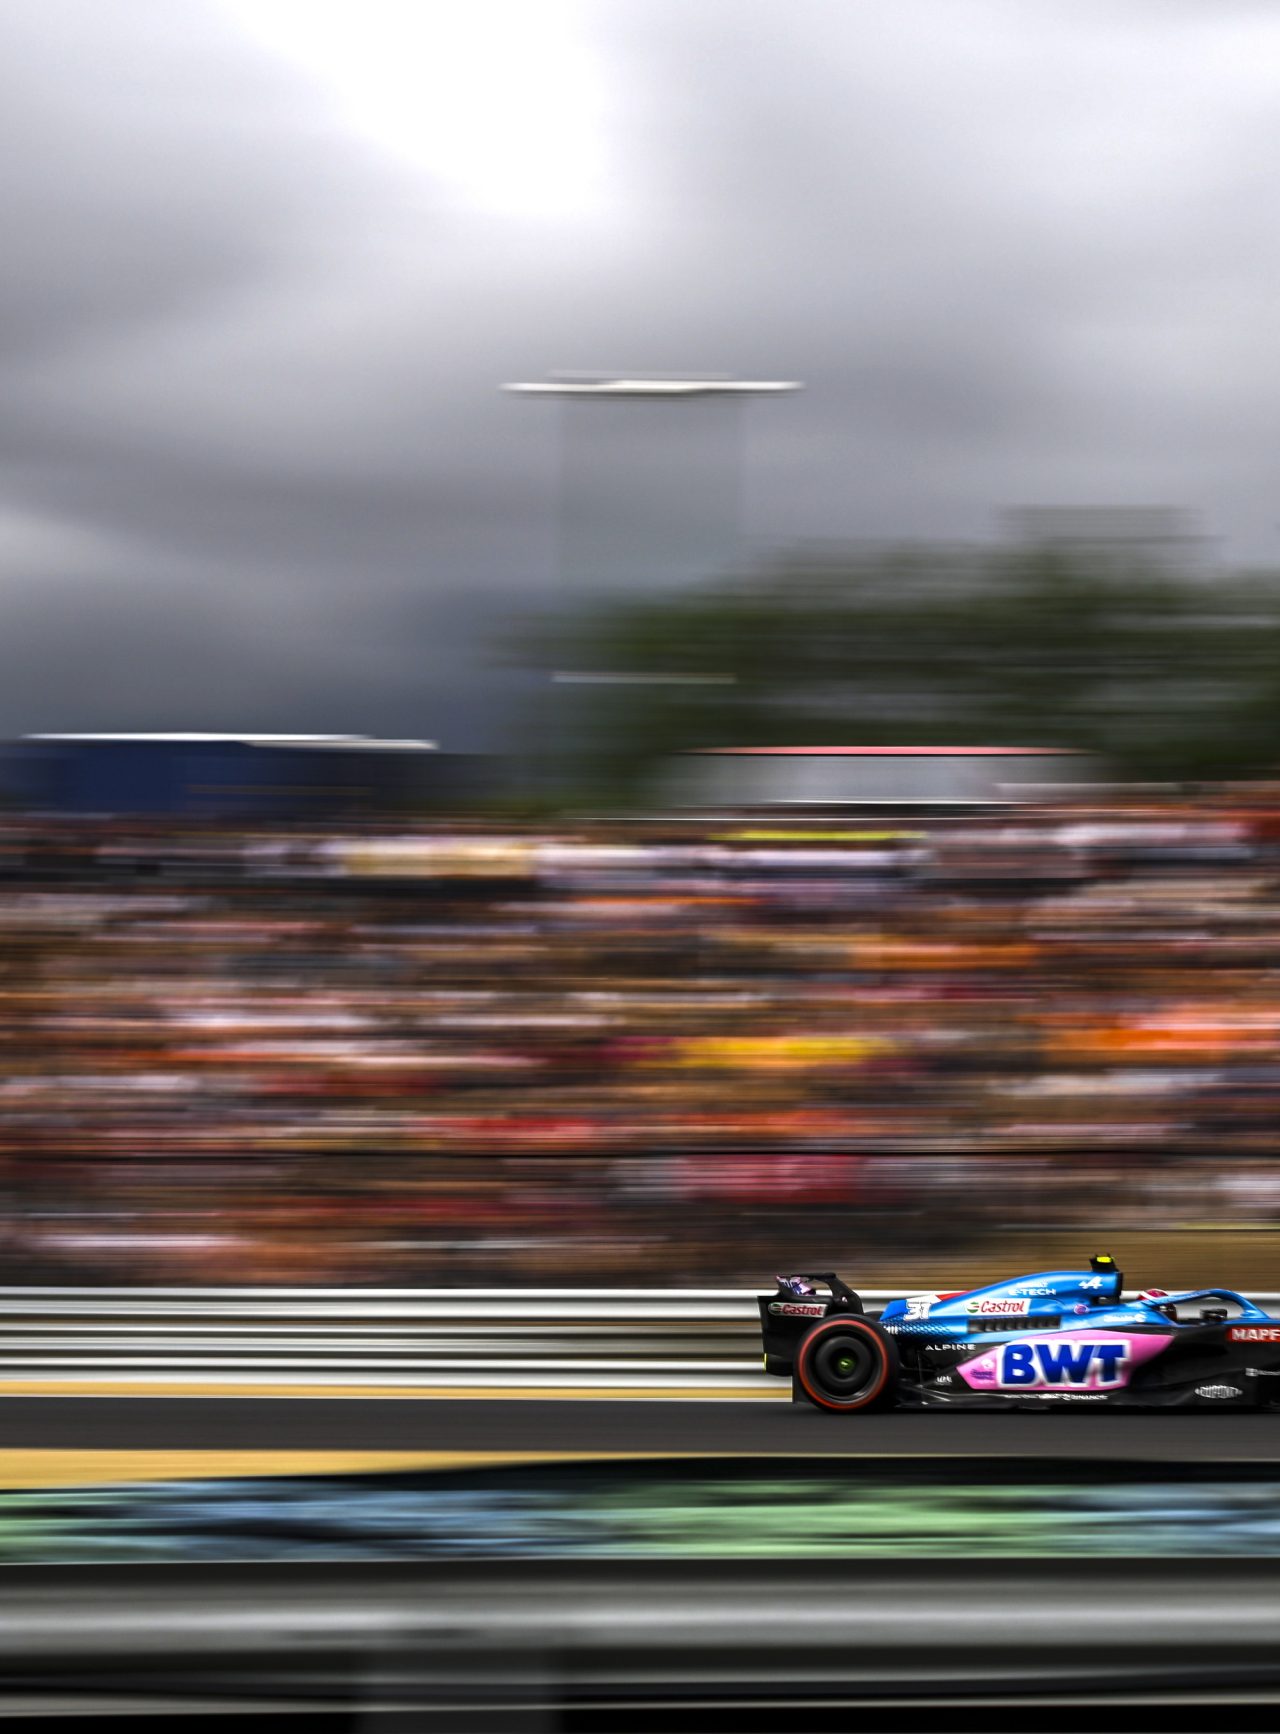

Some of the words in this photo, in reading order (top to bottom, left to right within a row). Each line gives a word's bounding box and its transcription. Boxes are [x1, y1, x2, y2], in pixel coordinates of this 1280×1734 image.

[782, 1304, 823, 1316] Castrol
[903, 1301, 932, 1320] 31
[980, 1300, 1025, 1314] Castrol
[925, 1343, 976, 1351] ALPINE
[1000, 1343, 1127, 1386] BWT
